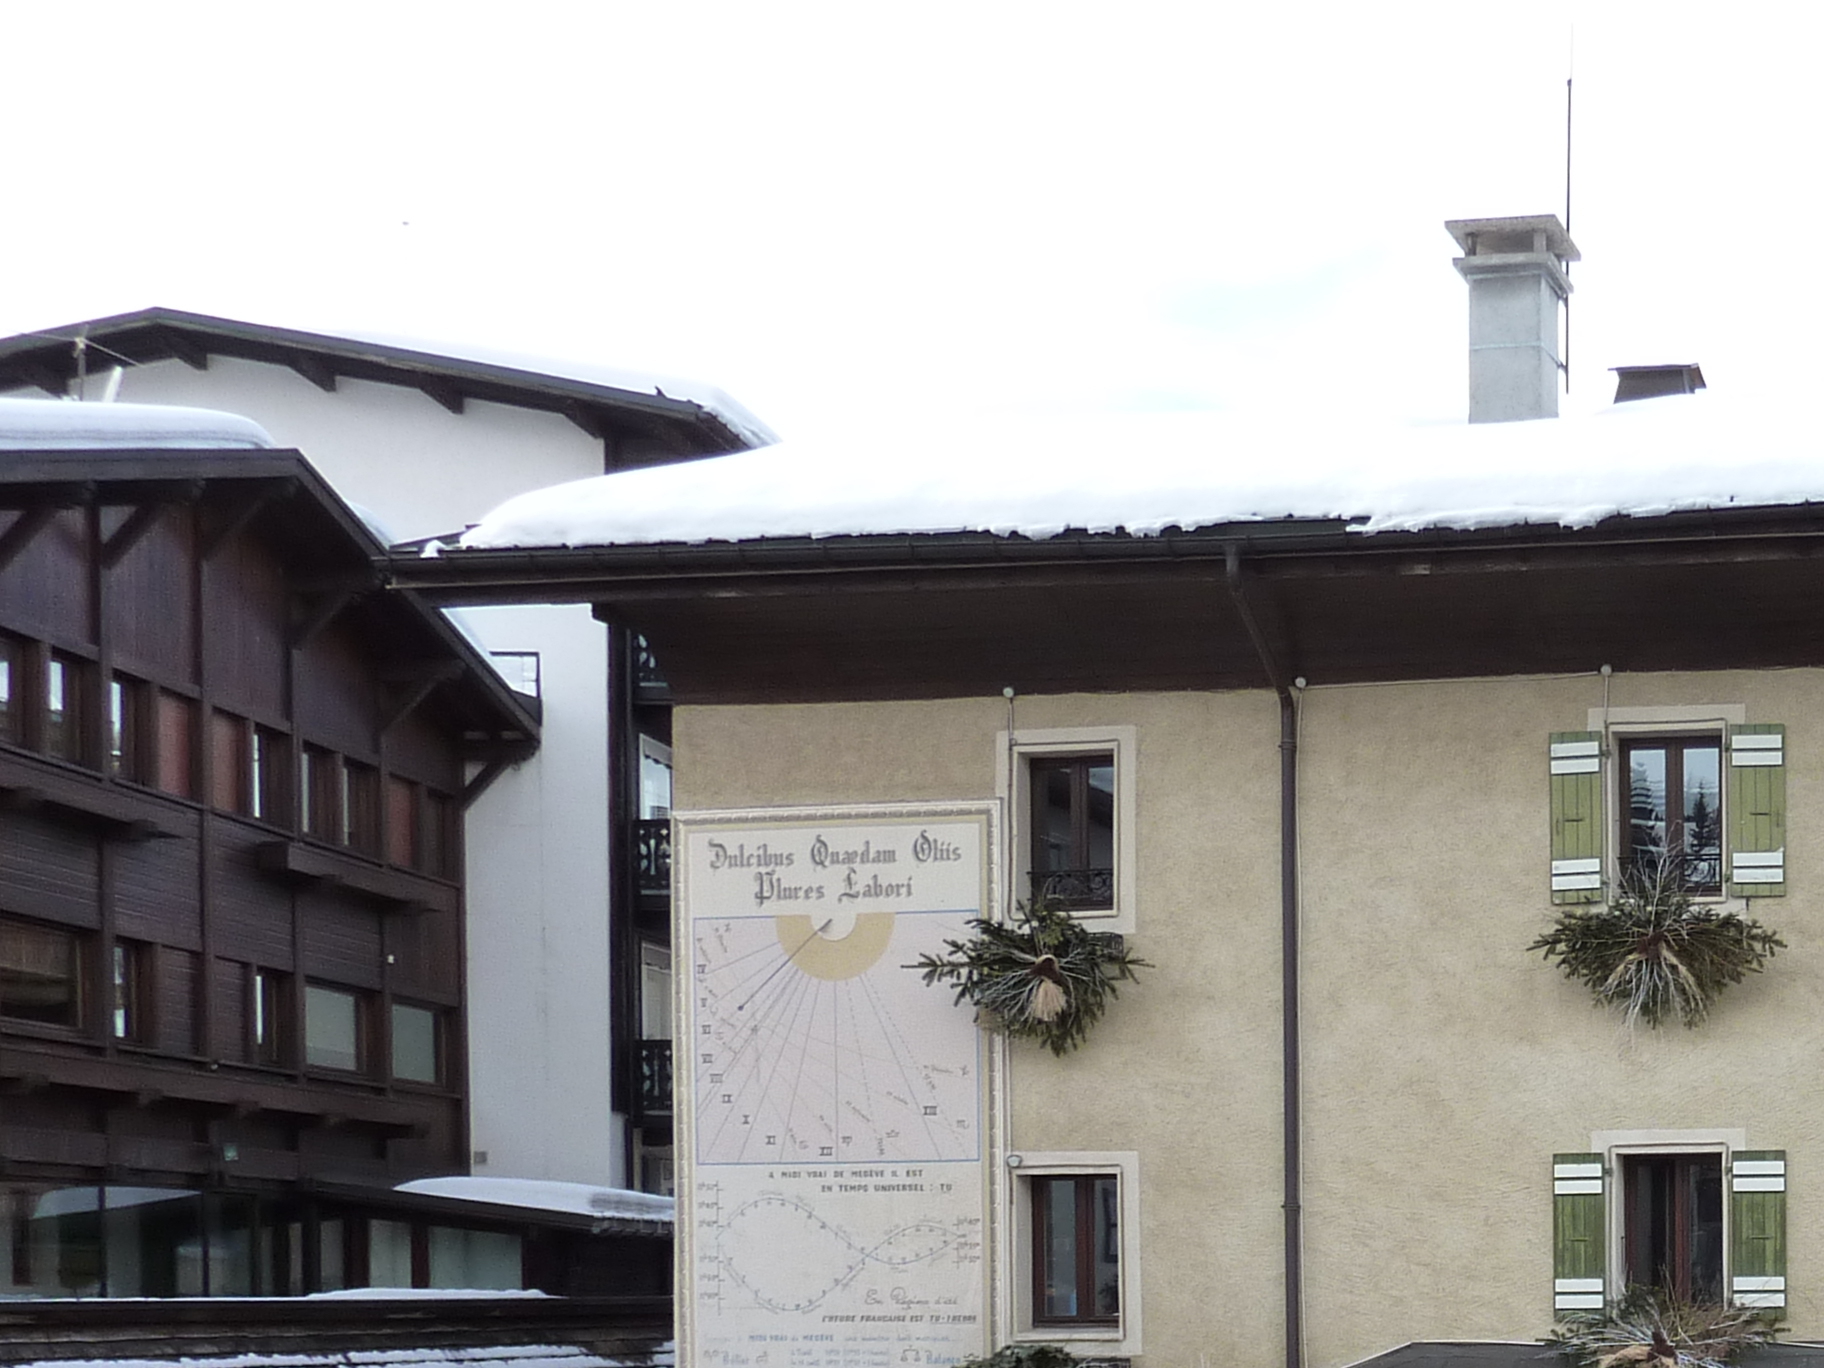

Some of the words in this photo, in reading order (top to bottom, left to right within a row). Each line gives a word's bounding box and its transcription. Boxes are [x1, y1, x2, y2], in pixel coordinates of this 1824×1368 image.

[708, 838, 795, 869] Dulcibus
[754, 869, 825, 907] Plures
[838, 866, 913, 903] Labori
